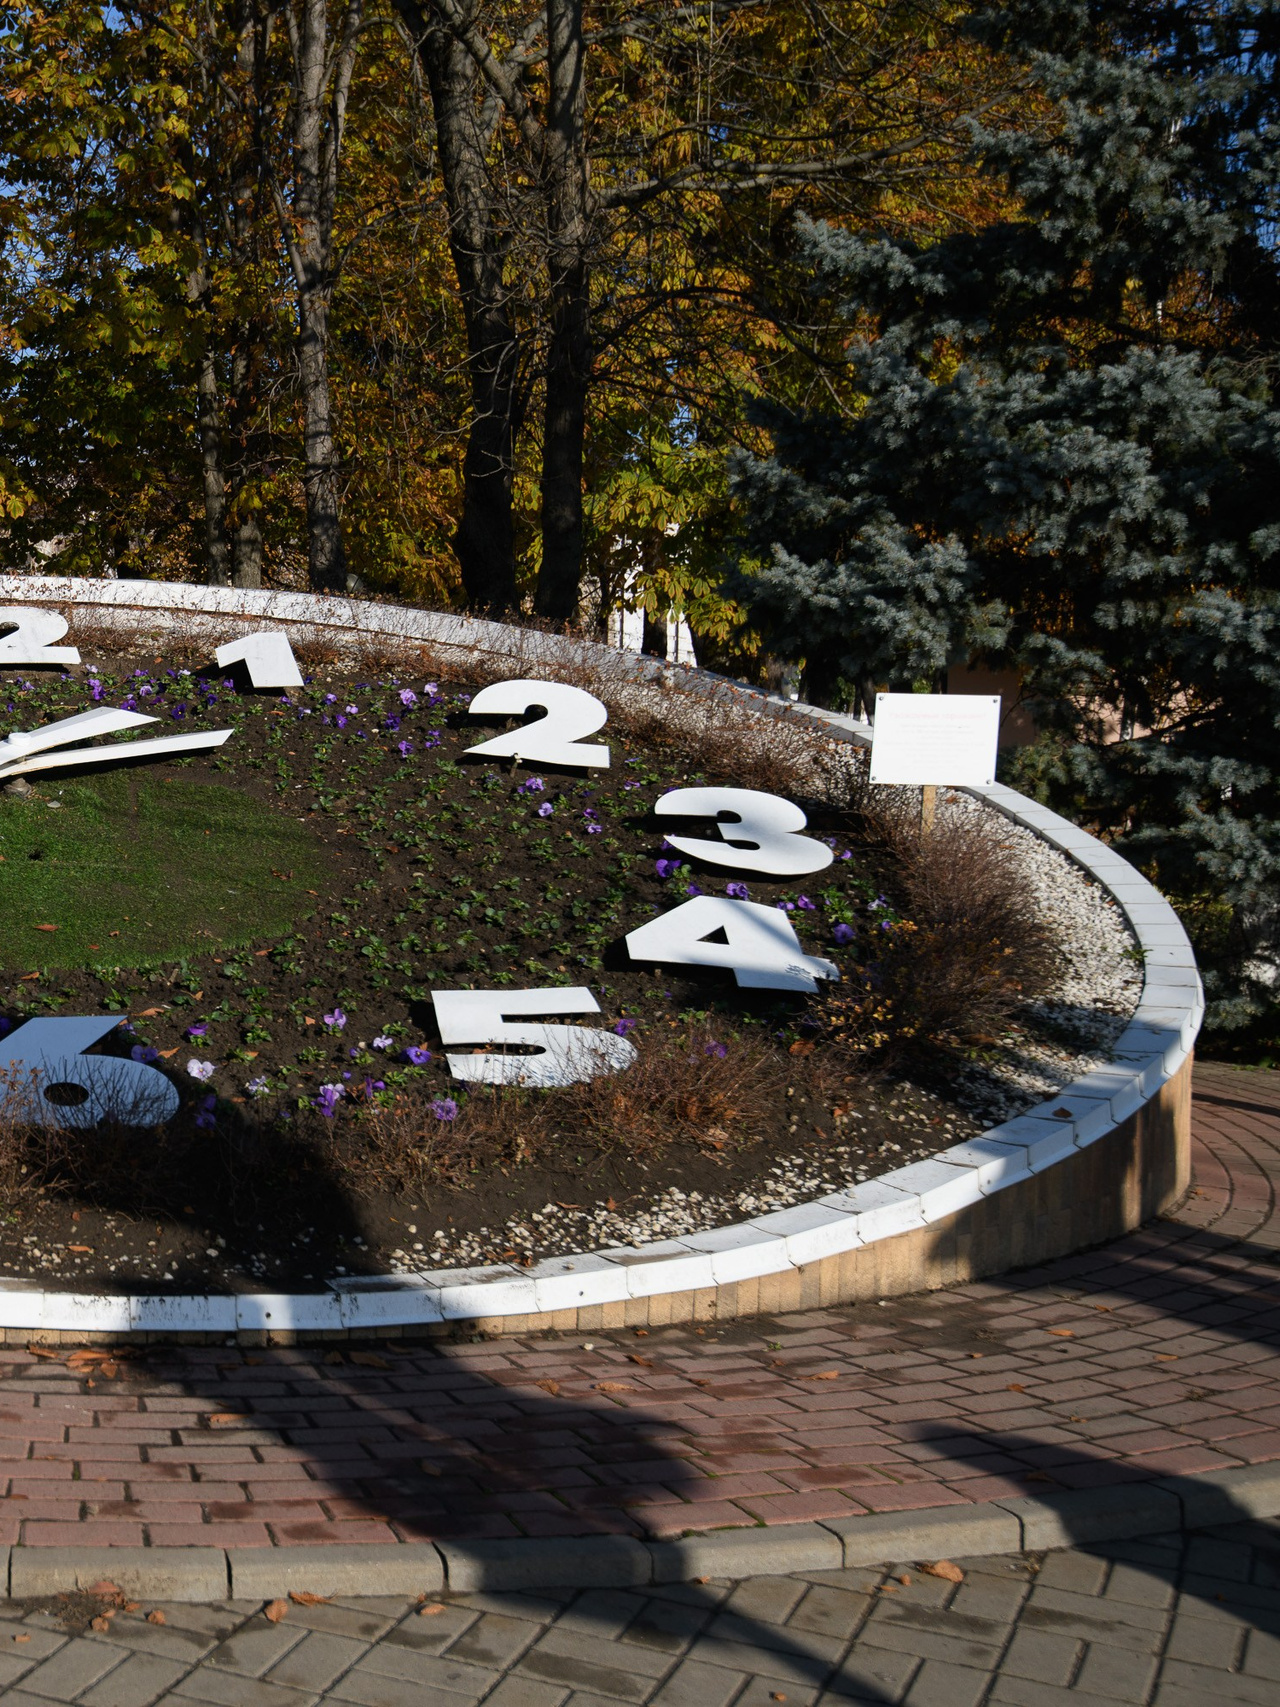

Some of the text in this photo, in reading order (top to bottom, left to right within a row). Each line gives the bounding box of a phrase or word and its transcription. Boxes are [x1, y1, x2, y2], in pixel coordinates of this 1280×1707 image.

[215, 631, 305, 688] 1
[462, 679, 610, 768] 2
[654, 787, 835, 876] 3
[625, 895, 840, 993] 4
[431, 986, 638, 1088] 5
